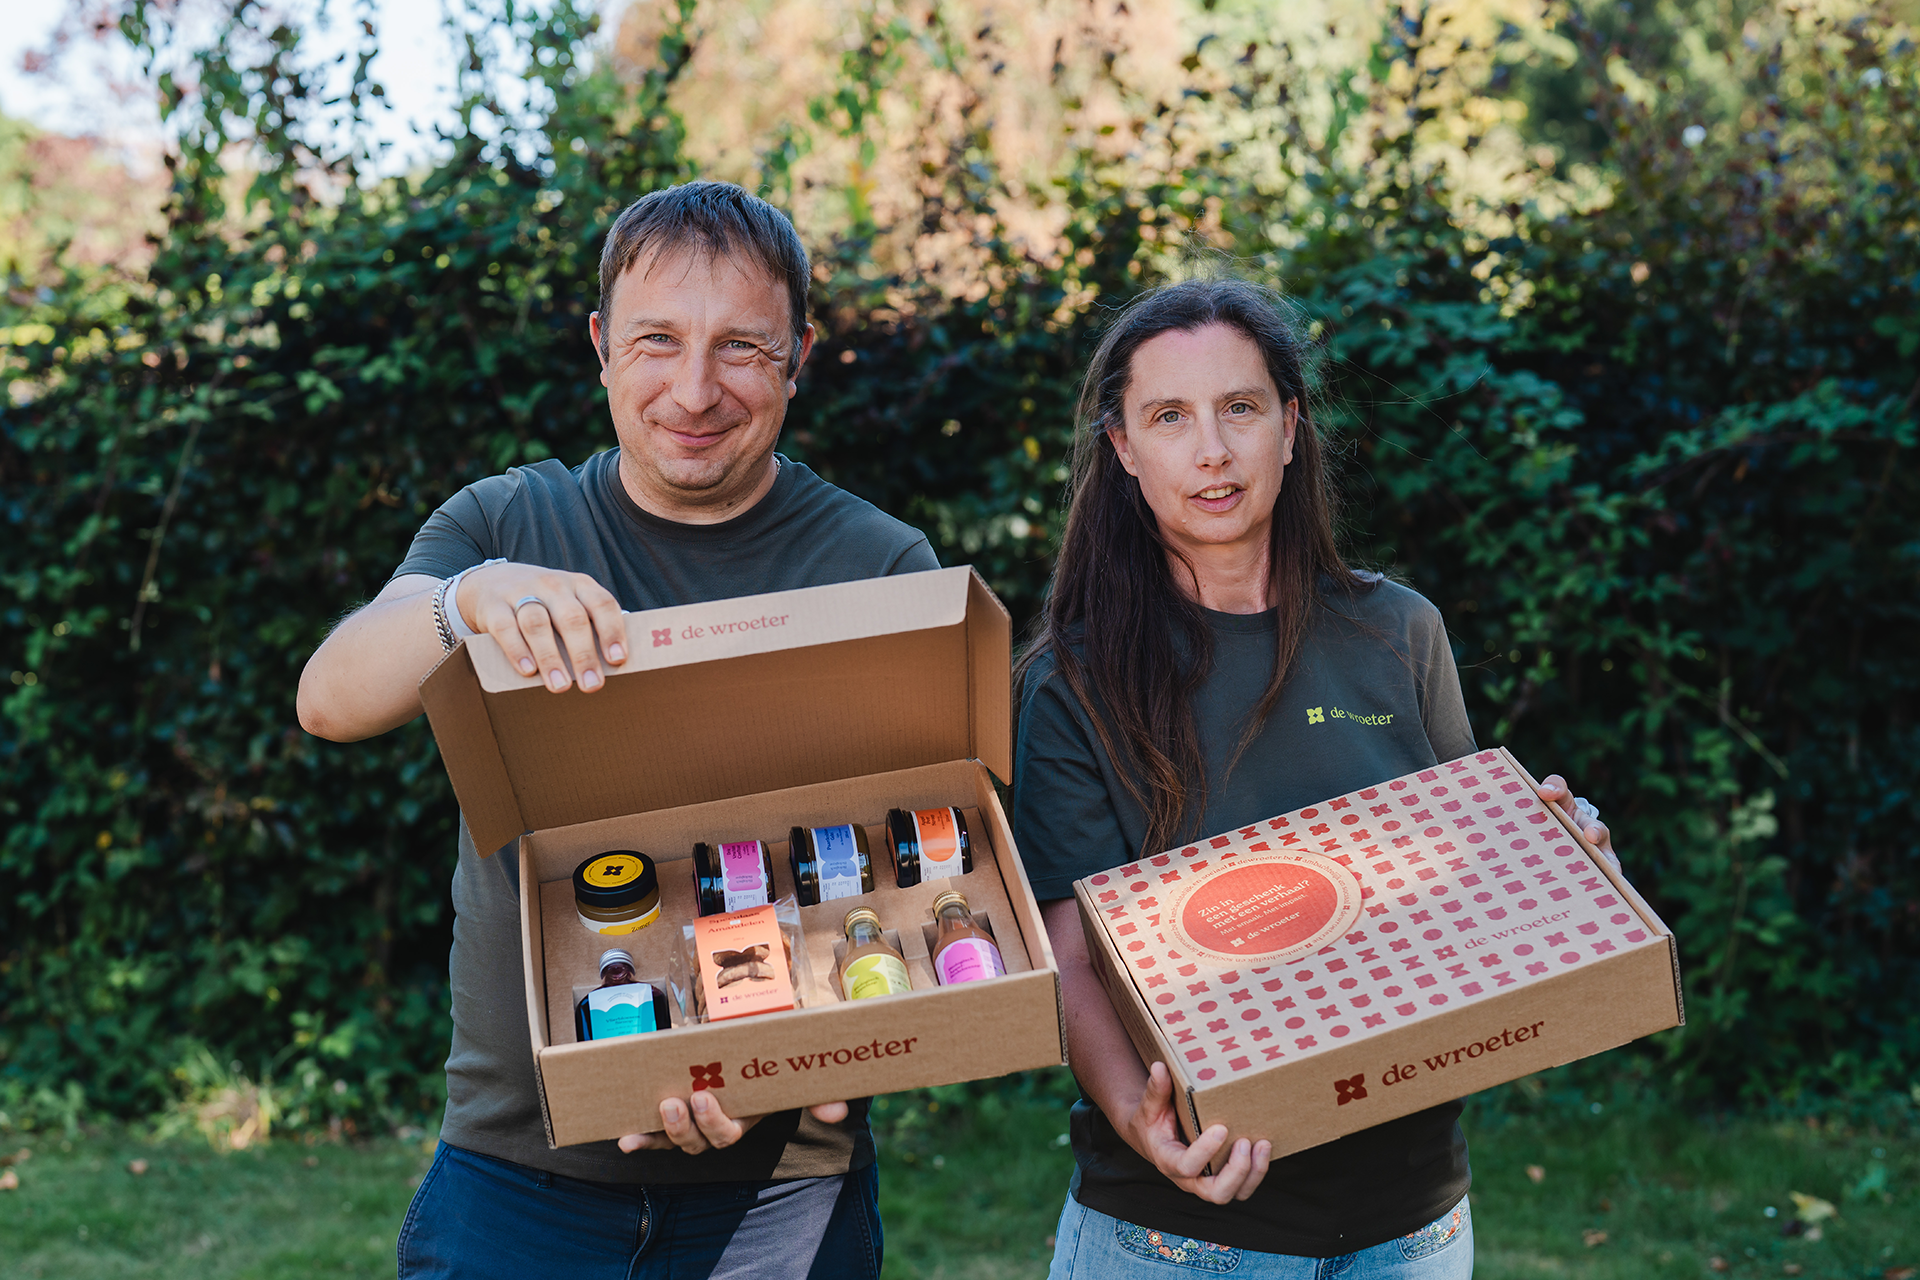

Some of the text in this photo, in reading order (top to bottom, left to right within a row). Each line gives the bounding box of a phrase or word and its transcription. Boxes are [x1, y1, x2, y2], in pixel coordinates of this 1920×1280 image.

[681, 614, 789, 640] de wroeter
[1330, 706, 1394, 725] de wroeter
[1201, 864, 1228, 880] sociaal
[1237, 855, 1294, 865] dewroeter.be
[1198, 898, 1234, 917] Zin in
[1206, 883, 1286, 923] een geschenk
[1212, 879, 1310, 929] met een verhaal?
[1220, 893, 1308, 935] Met smaak. Met impact.
[708, 920, 765, 934] Amandelen
[1247, 911, 1300, 940] de wroeter
[1464, 910, 1570, 949] de wroeter
[732, 987, 779, 1001] de wroeter
[741, 1037, 918, 1080] de wroeter
[1382, 1021, 1545, 1086] de wroeter
